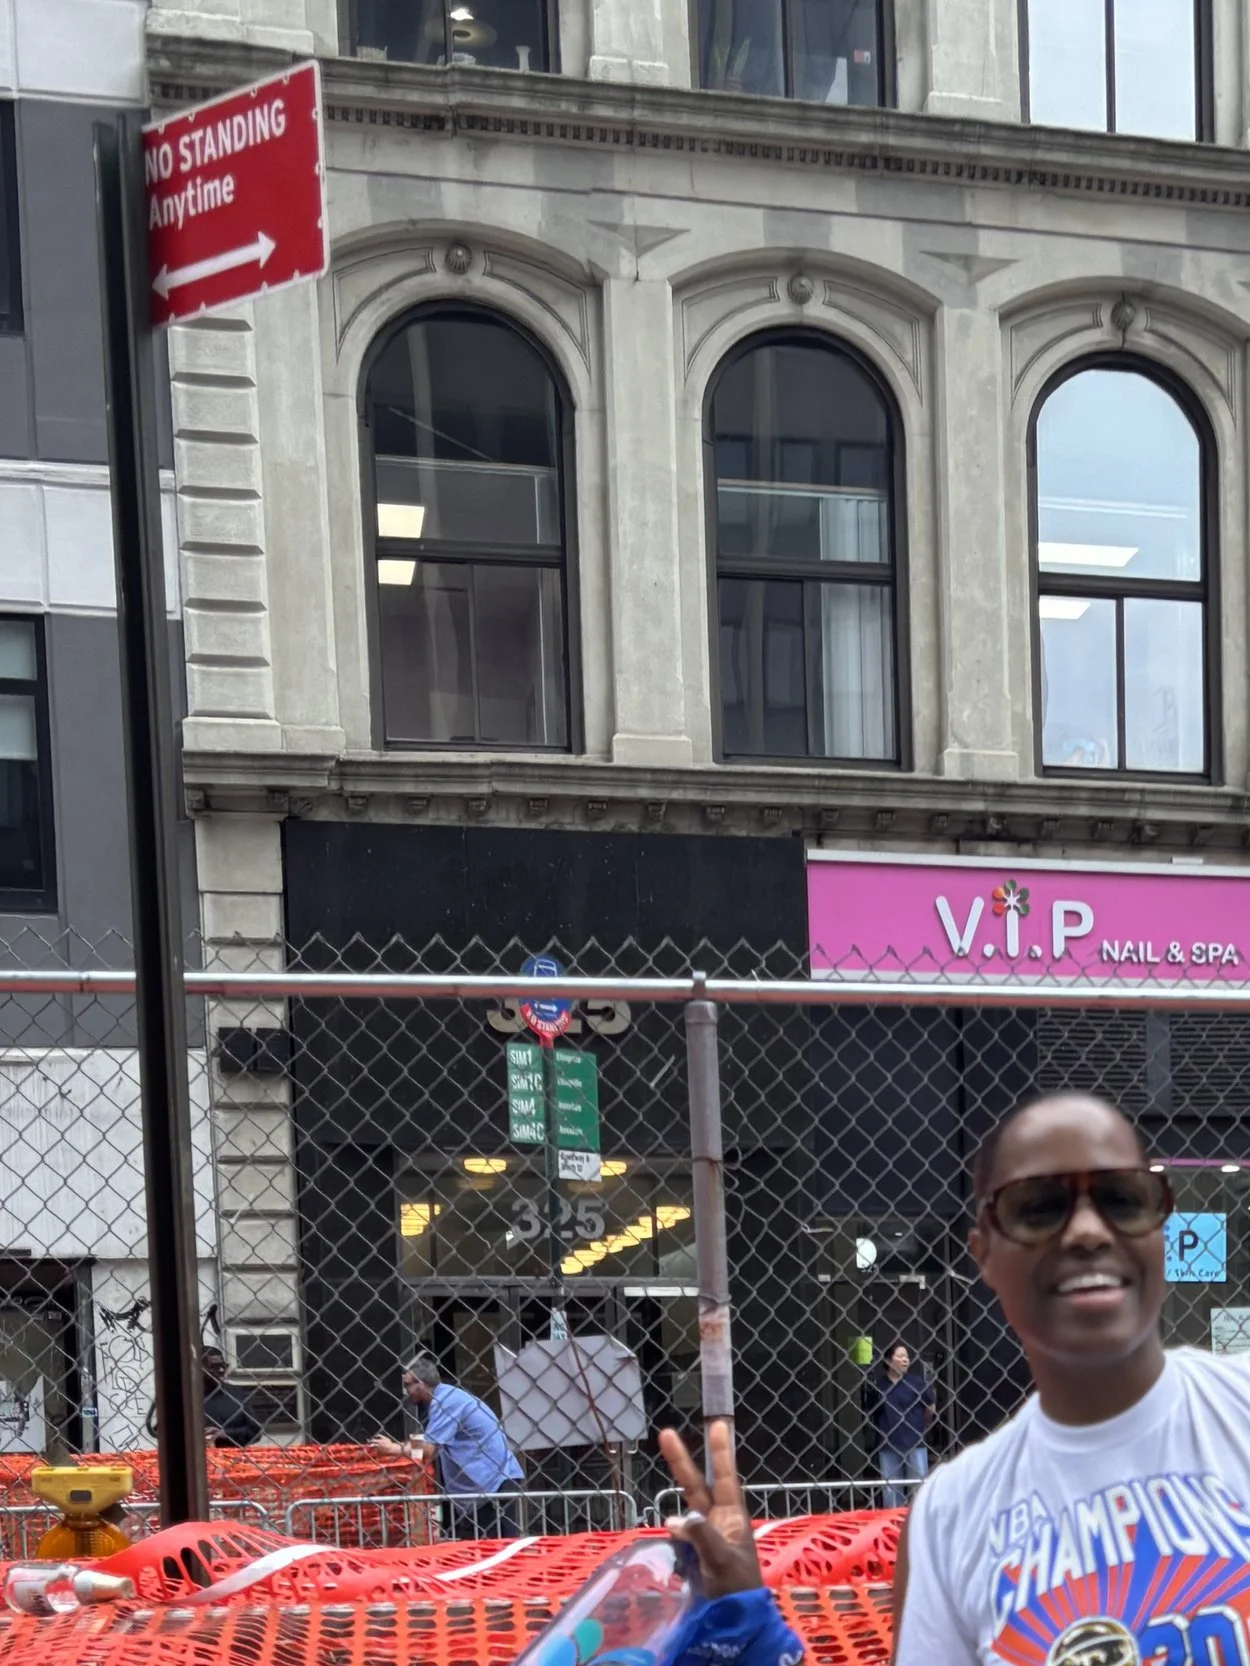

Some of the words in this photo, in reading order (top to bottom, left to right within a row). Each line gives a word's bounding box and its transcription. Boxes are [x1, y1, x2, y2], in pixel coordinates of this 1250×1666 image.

[145, 143, 173, 187] NO
[179, 99, 286, 173] STANDING
[150, 174, 235, 230] Anytime
[1102, 939, 1160, 964] NAIL
[1167, 943, 1185, 963] &
[1191, 943, 1239, 965] SPA
[509, 1049, 533, 1066] SIM1
[989, 1491, 1048, 1552] NBA
